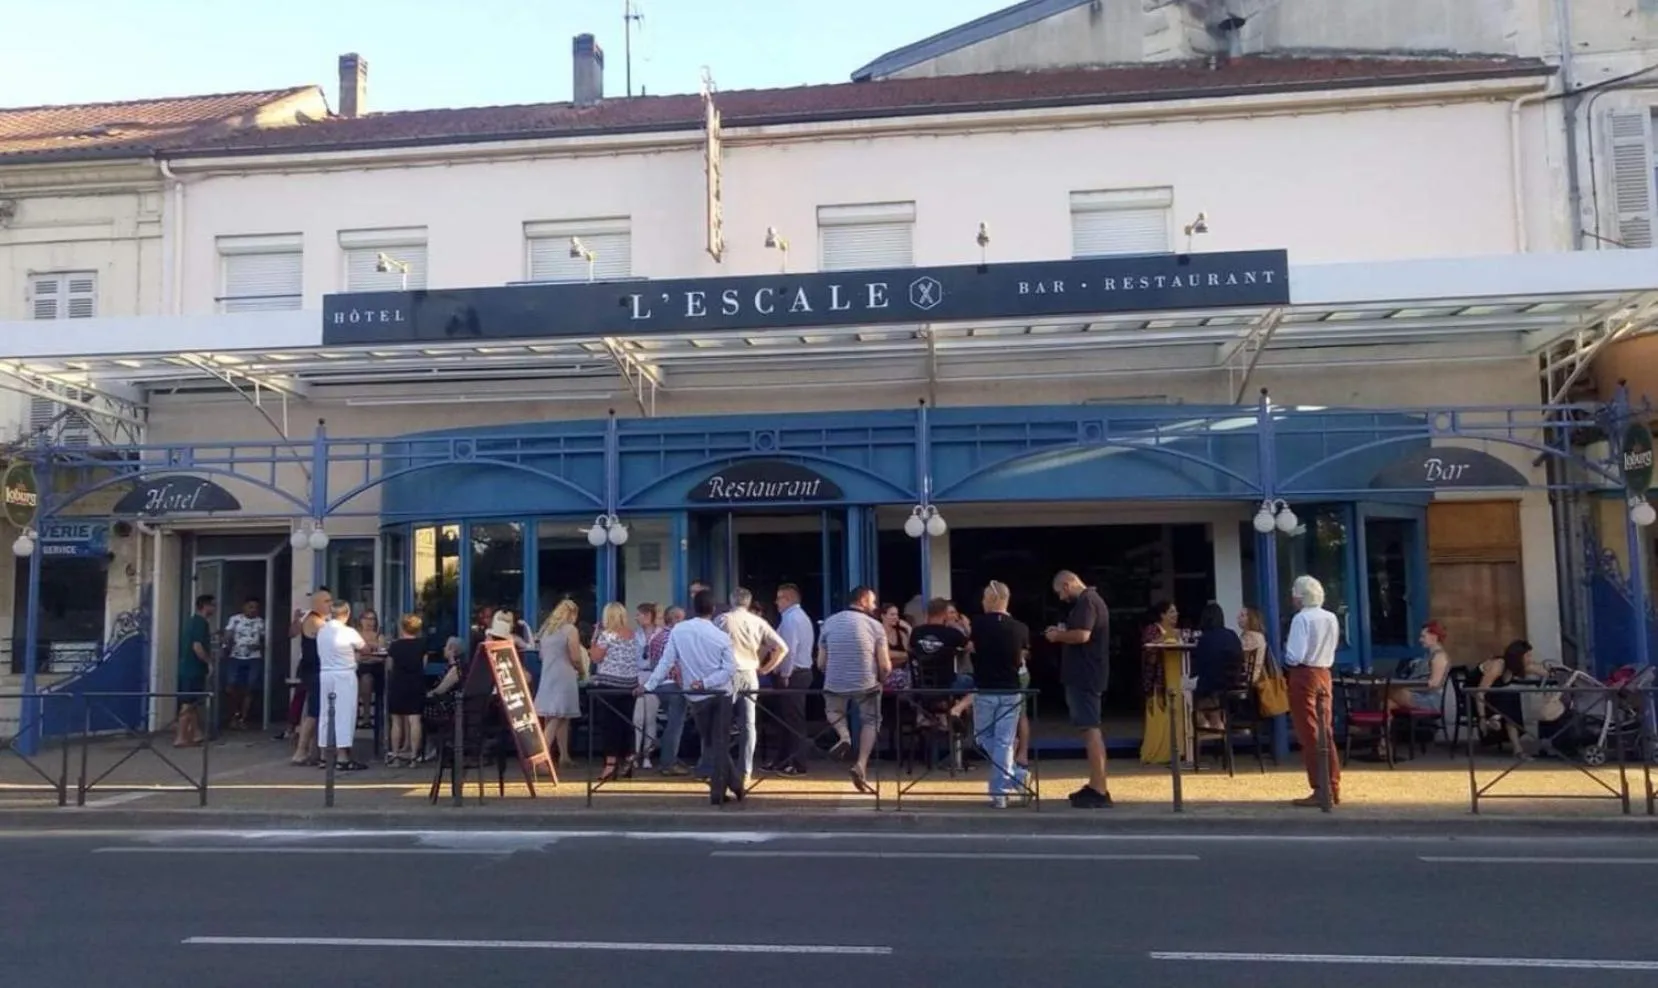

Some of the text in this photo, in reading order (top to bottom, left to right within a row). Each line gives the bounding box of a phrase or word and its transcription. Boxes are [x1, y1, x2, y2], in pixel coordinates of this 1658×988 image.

[1018, 270, 1275, 294] BAR RESTAURANT
[630, 282, 889, 320] L'ESCALE
[334, 307, 404, 324] HÔTEL
[1423, 458, 1470, 481] Bar
[145, 485, 202, 509] Hotel
[708, 476, 820, 498] Restaurant
